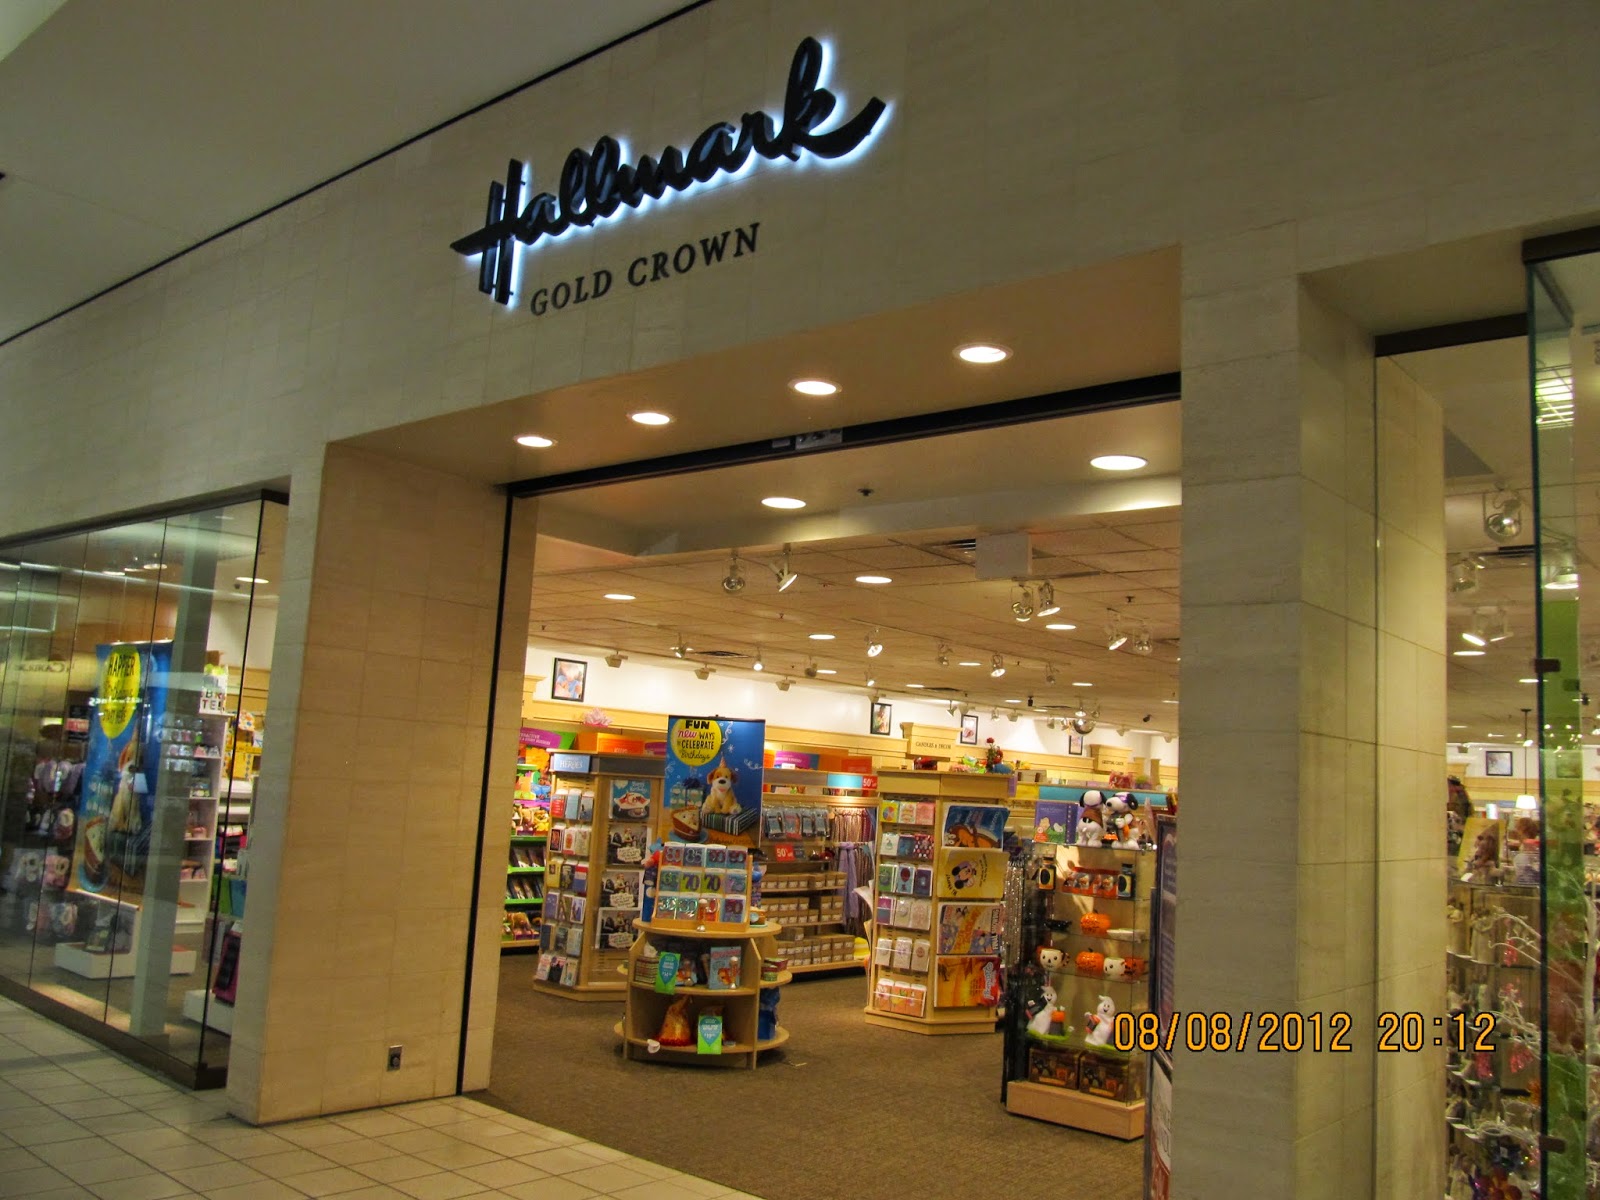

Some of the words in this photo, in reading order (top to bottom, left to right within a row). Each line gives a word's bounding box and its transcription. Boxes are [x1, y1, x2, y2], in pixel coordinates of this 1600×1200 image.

[450, 36, 886, 305] Hallmark
[530, 269, 612, 316] GOLD
[627, 222, 760, 287] CROWN
[685, 719, 710, 729] FUN
[677, 730, 698, 739] new
[699, 732, 715, 740] WAYS
[681, 740, 714, 750] CELEBRATE
[683, 872, 700, 891] 70
[704, 873, 721, 891] 70
